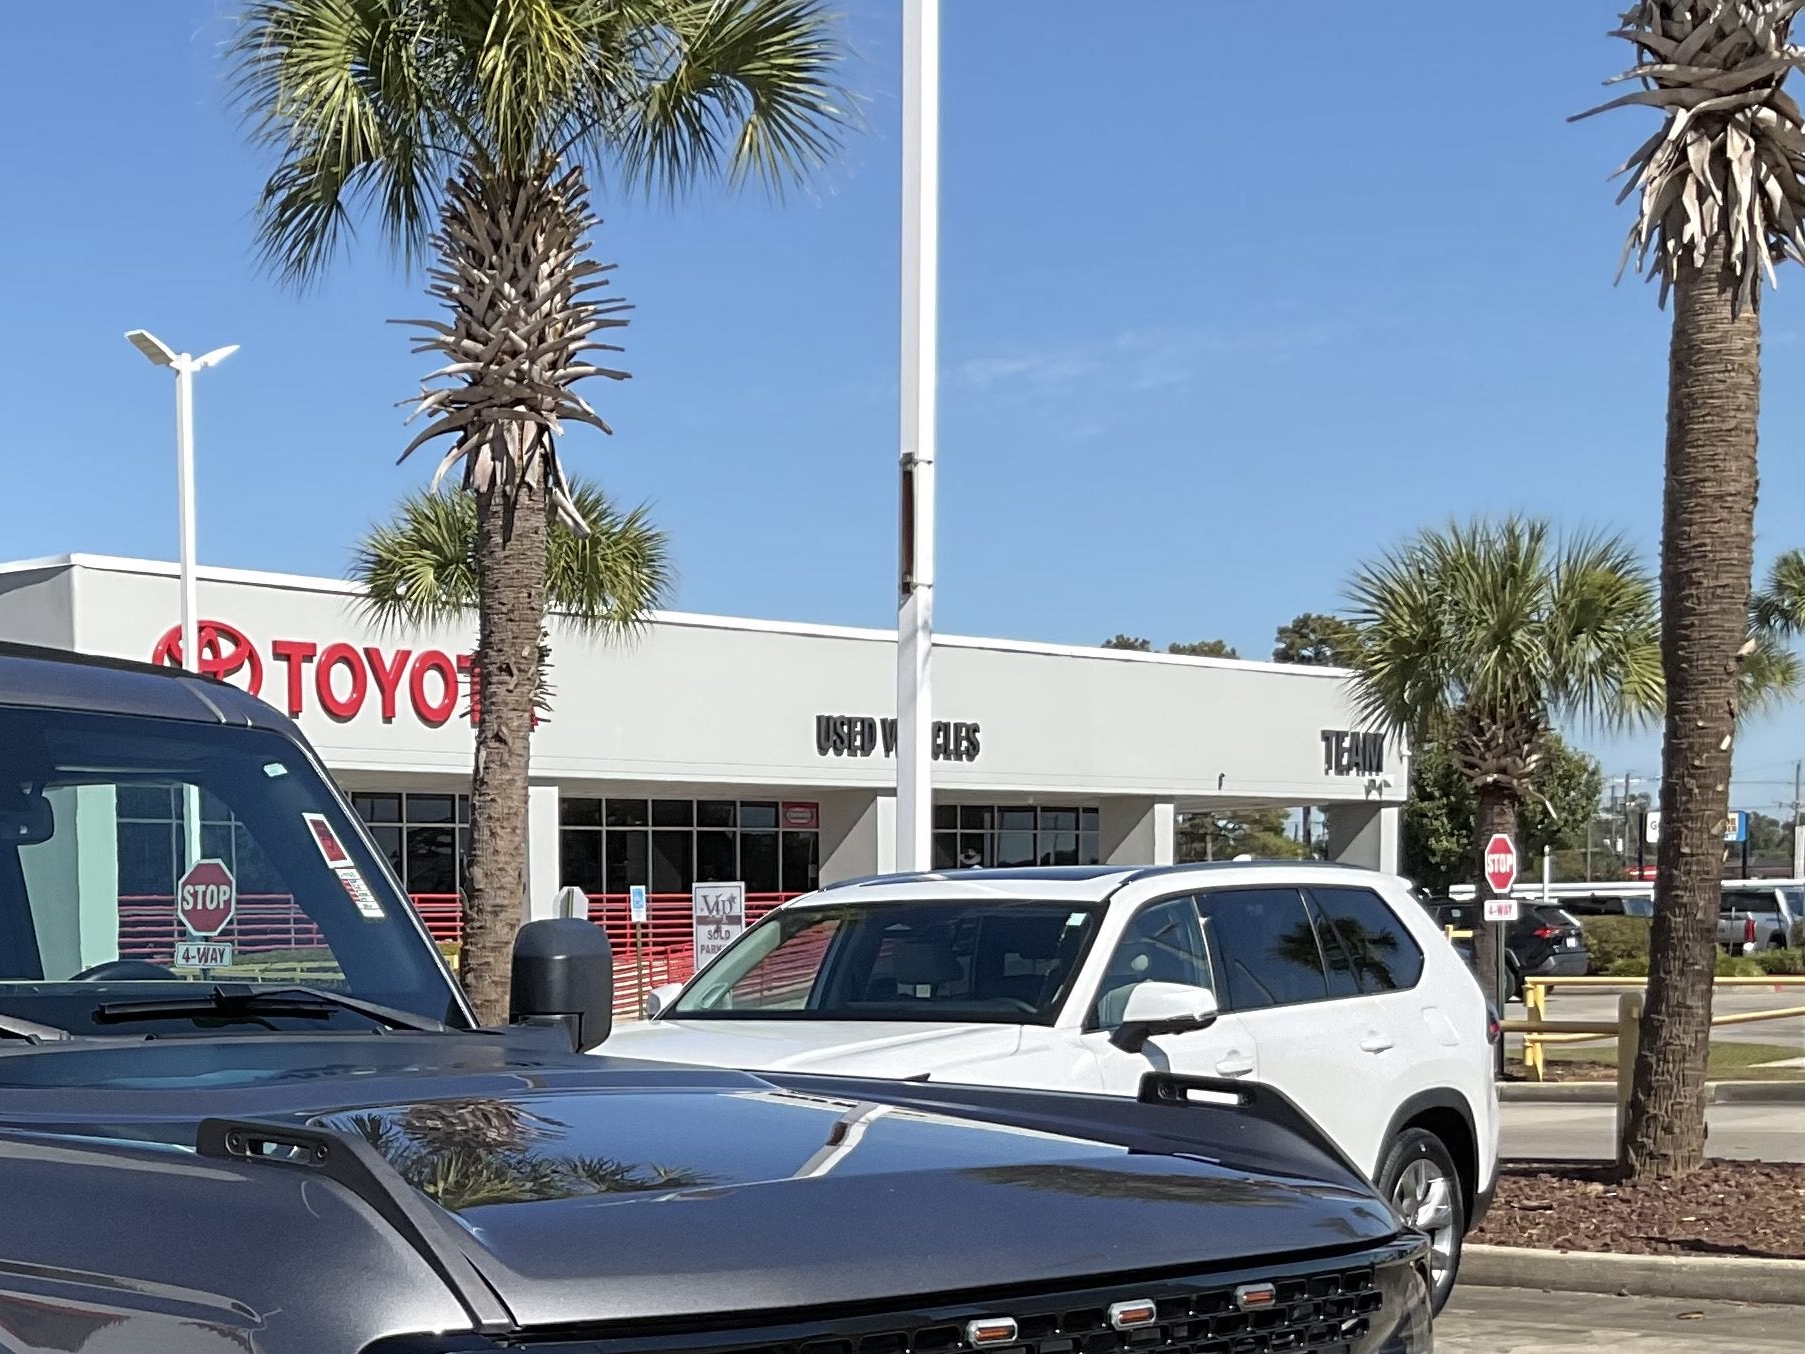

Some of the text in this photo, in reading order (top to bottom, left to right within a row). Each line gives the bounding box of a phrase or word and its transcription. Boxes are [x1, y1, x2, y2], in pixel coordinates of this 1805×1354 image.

[272, 640, 538, 729] TOYOT
[815, 714, 981, 762] USED VCLES
[1320, 730, 1384, 777] TEAM
[1487, 853, 1513, 873] STOP
[182, 884, 231, 910] STOP
[1488, 904, 1513, 916] 4-WAY
[707, 930, 731, 941] SOLD
[181, 946, 226, 964] 4-WAY
[700, 944, 724, 955] PARK
